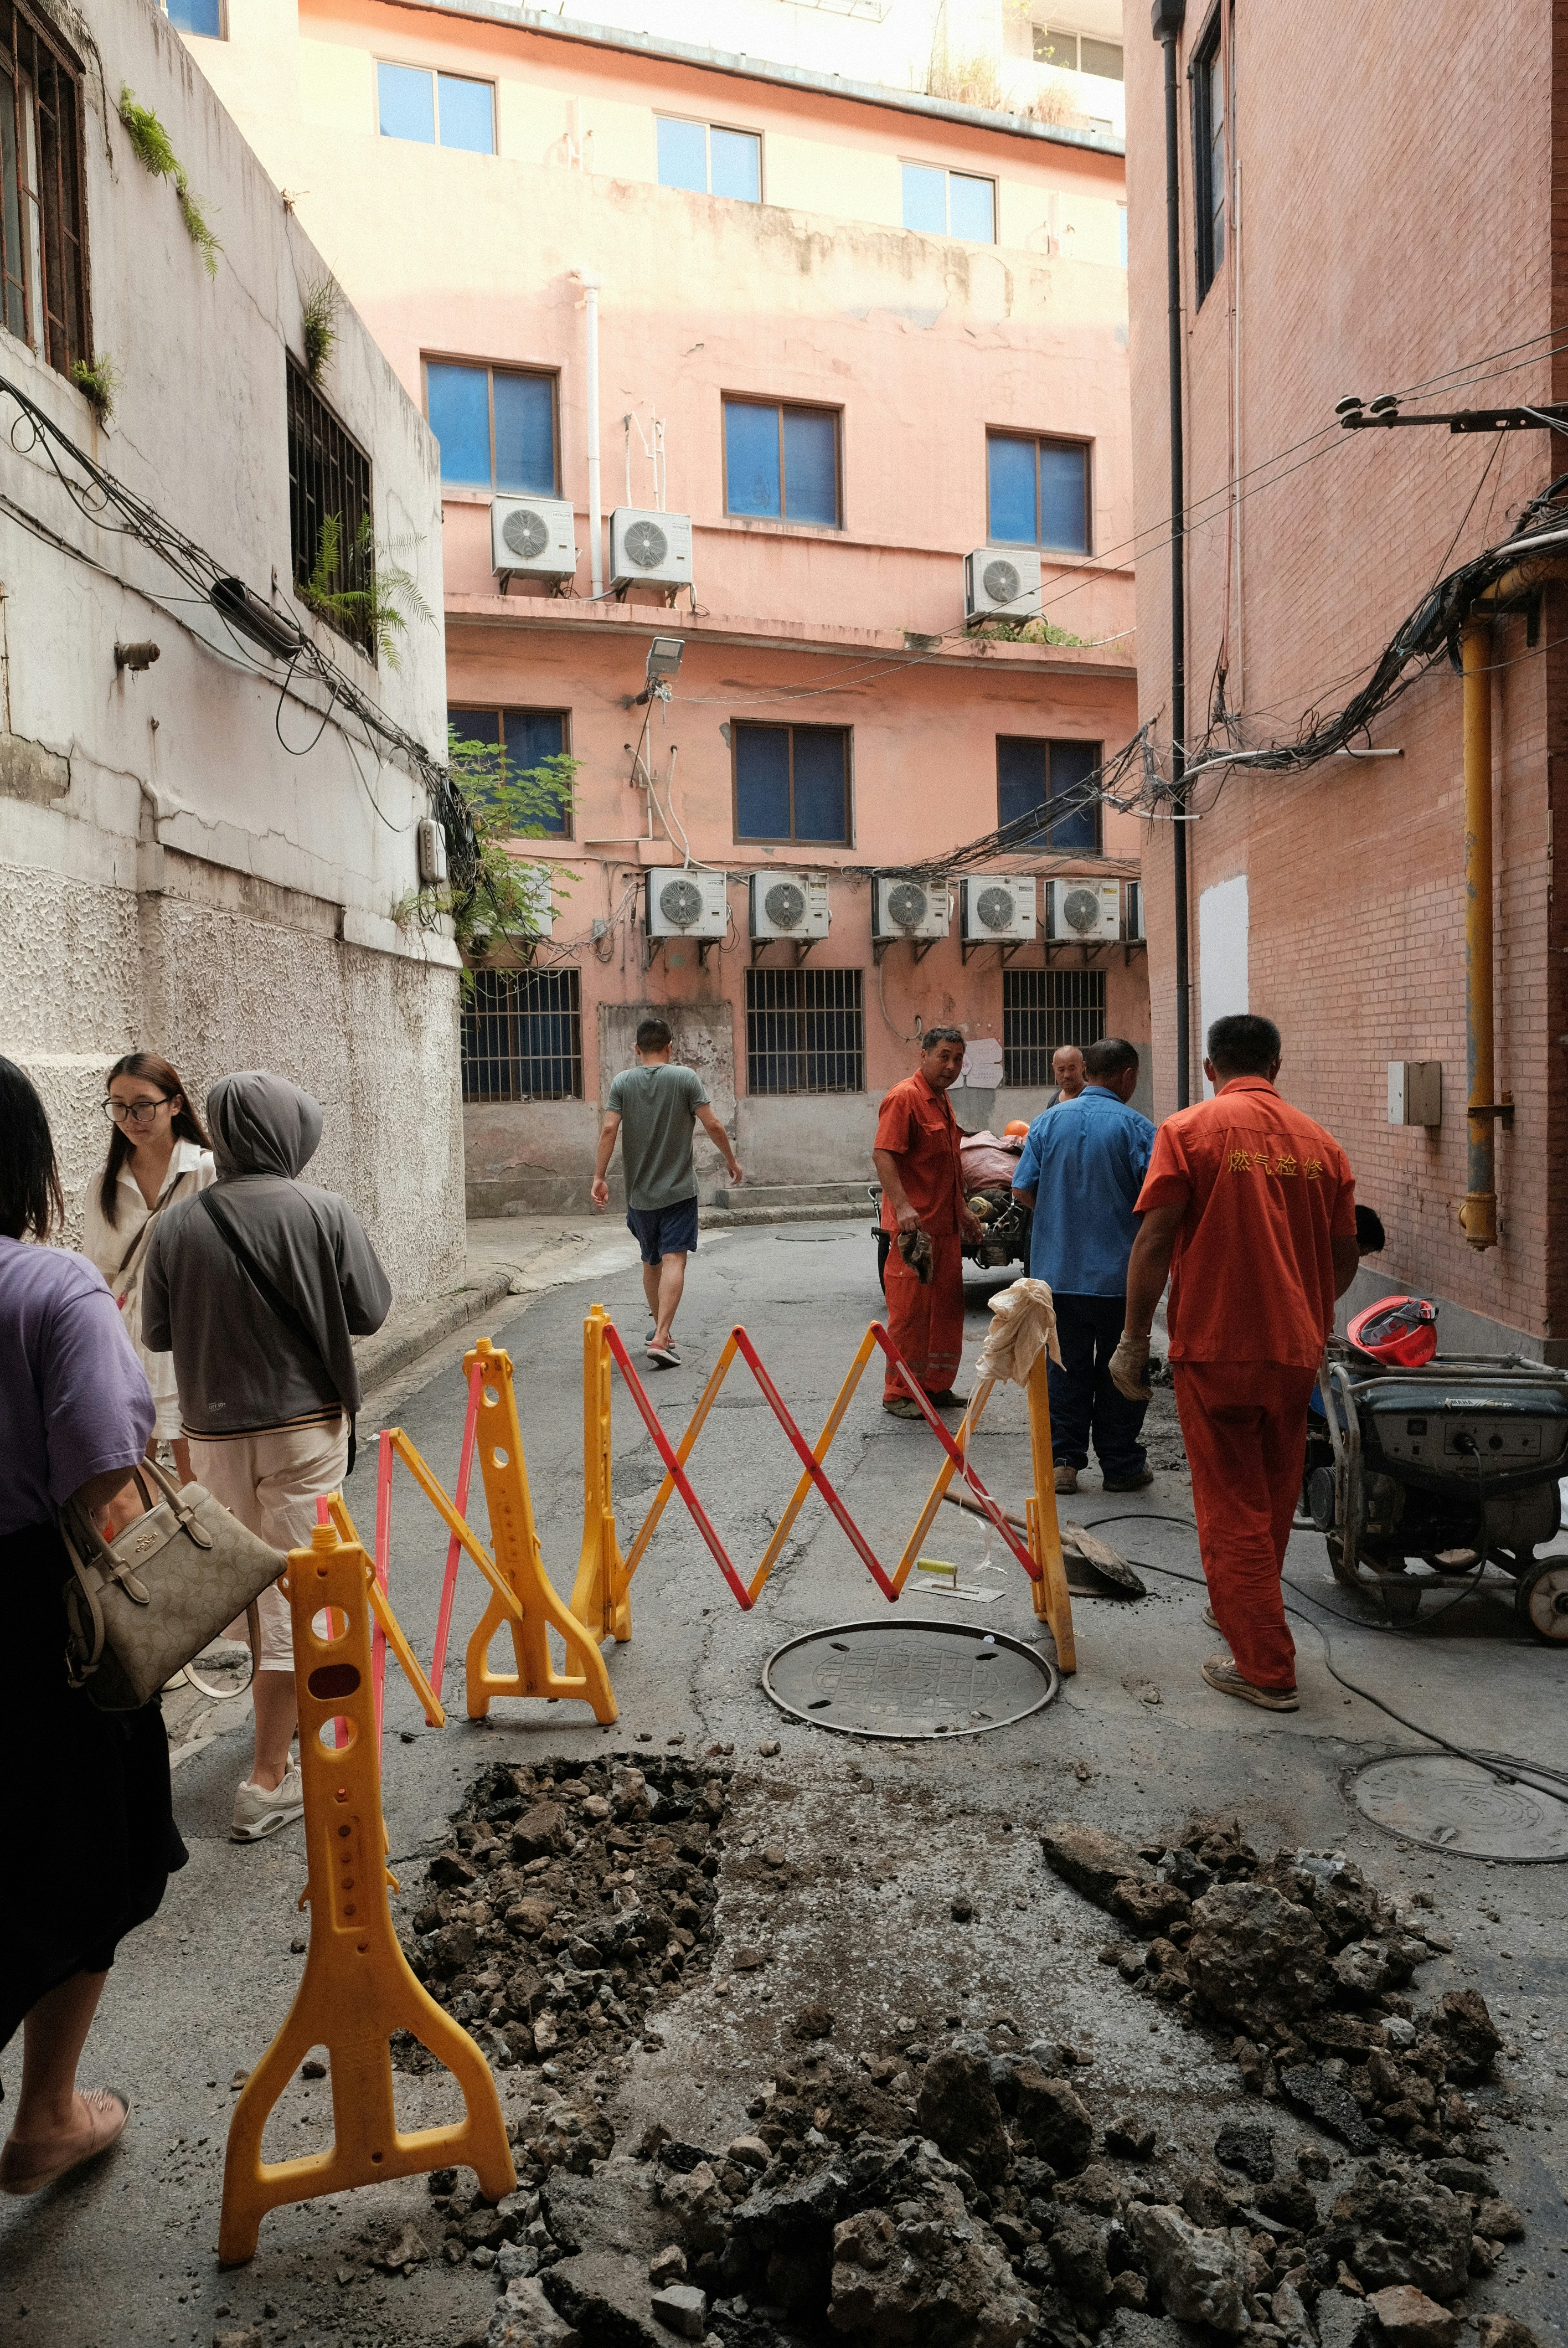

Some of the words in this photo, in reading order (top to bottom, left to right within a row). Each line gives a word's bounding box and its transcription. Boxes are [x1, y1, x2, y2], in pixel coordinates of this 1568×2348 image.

[1227, 1149, 1323, 1180] 燃气检修
[135, 1532, 158, 1553] COACH
